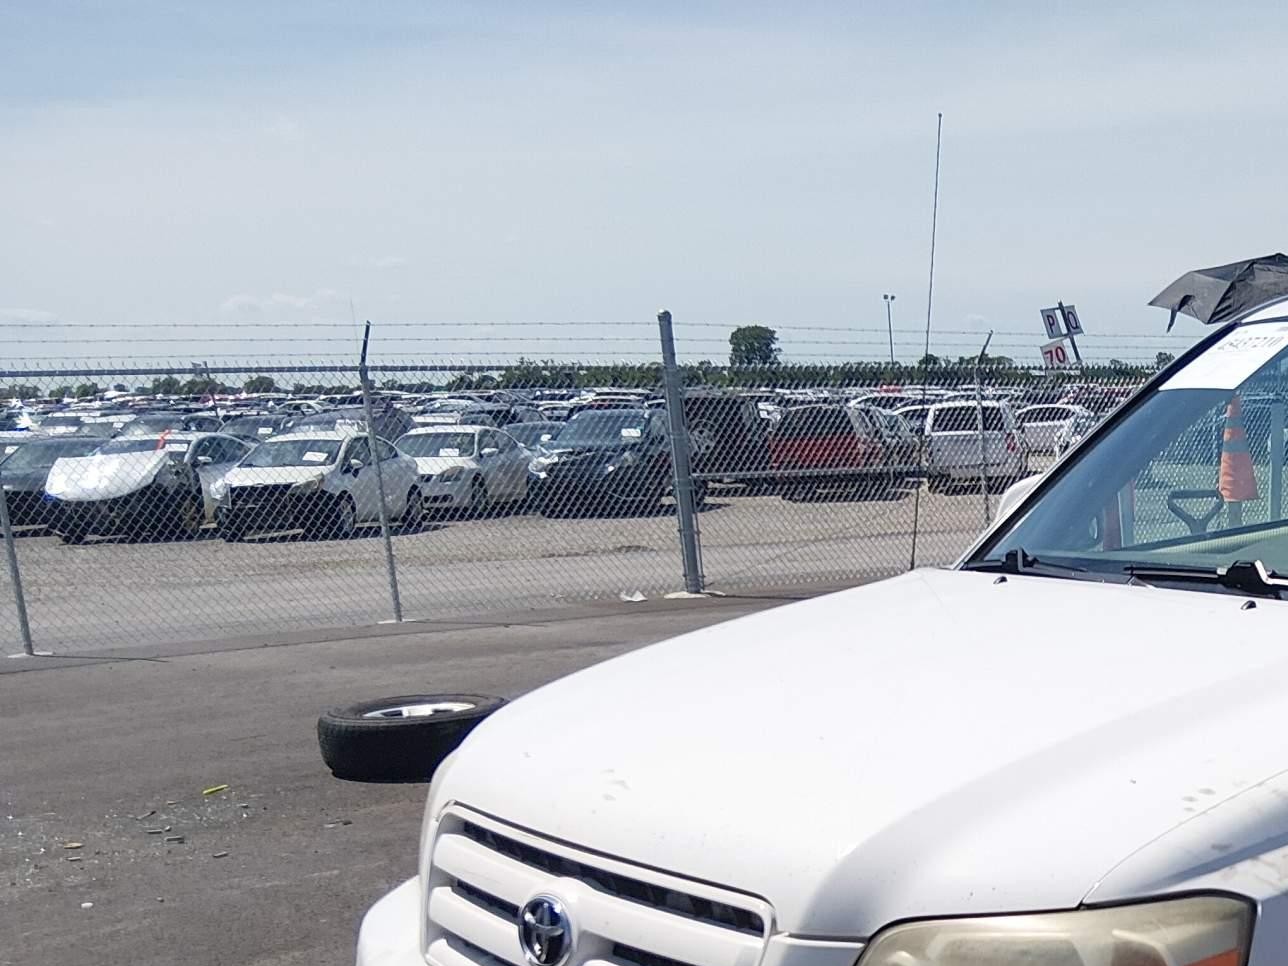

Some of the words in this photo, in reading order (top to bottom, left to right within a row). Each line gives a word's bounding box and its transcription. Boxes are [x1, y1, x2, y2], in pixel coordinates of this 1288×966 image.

[1046, 314, 1056, 334] P
[1066, 310, 1079, 330] Q
[1044, 346, 1066, 367] 70
